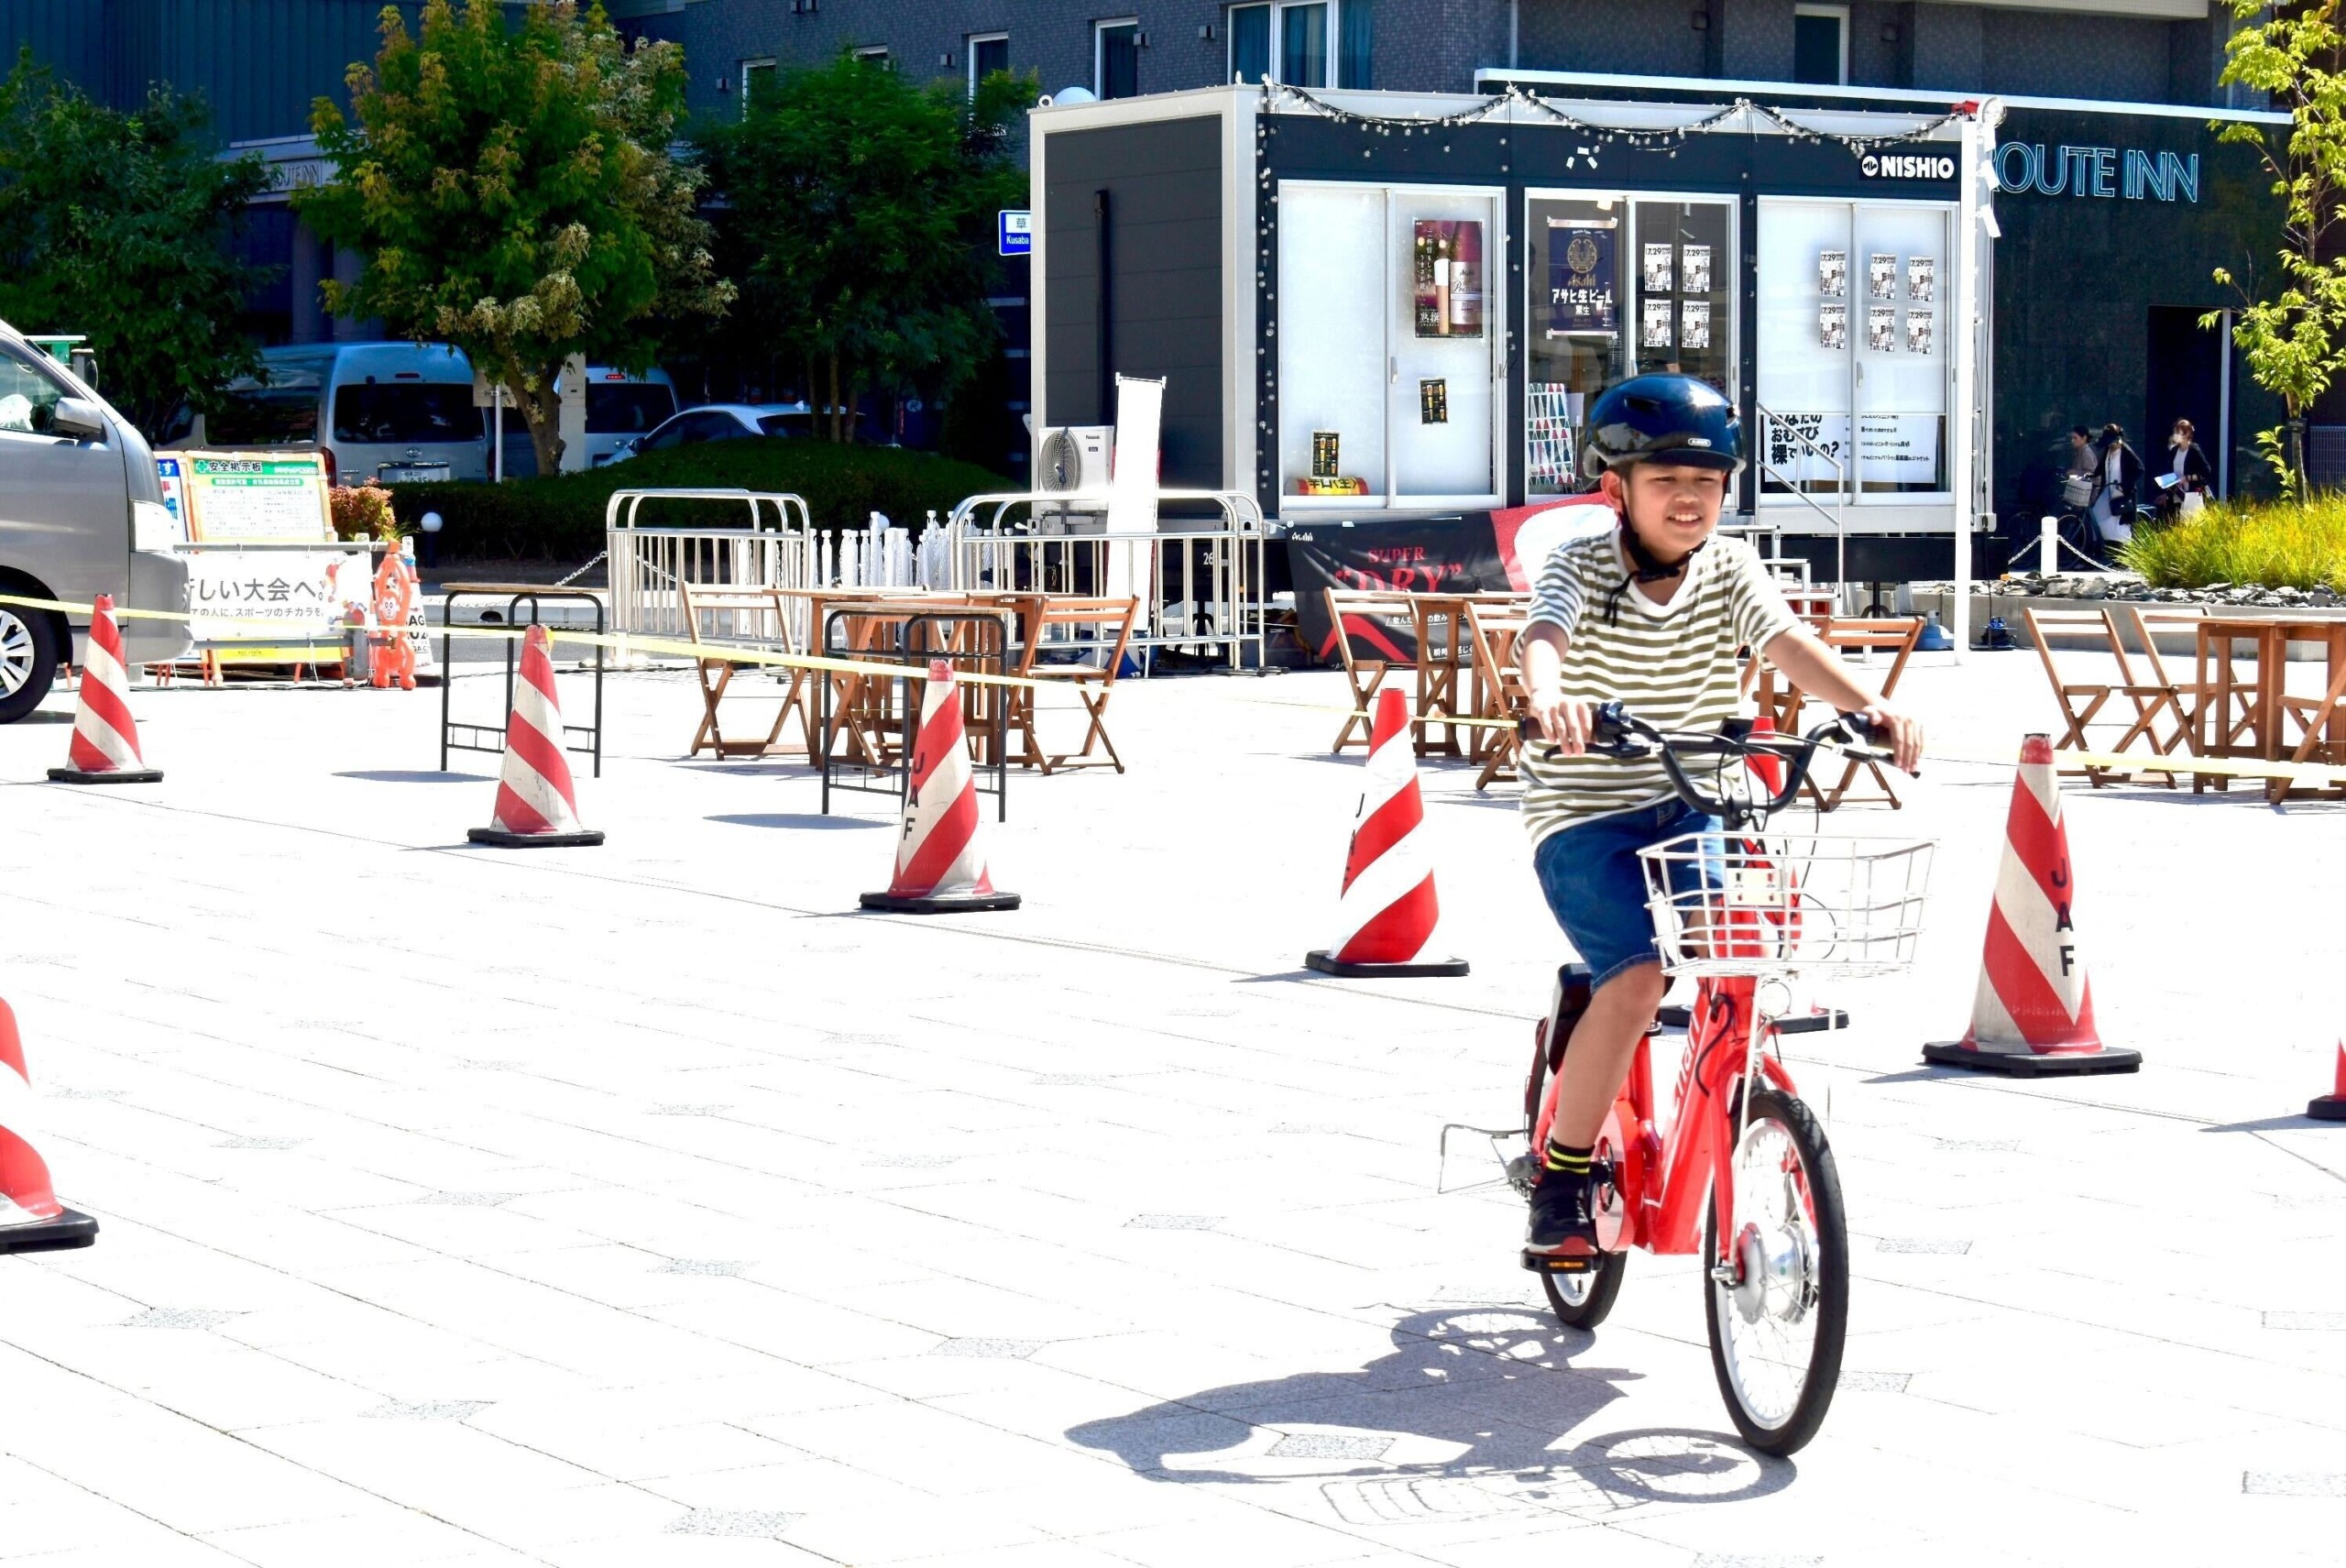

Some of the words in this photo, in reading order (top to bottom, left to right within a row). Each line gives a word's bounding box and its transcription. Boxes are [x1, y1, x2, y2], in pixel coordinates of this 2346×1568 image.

[1881, 156, 1955, 179] NISHIO
[1990, 141, 2116, 199] OUTE
[2124, 148, 2199, 203] INN
[1551, 289, 1613, 303] アサヒ生ビール
[209, 461, 262, 472] 安全掲示板
[1291, 532, 1313, 542] Asahi
[1368, 546, 1426, 564] SUPER
[2051, 857, 2074, 977] JAF
